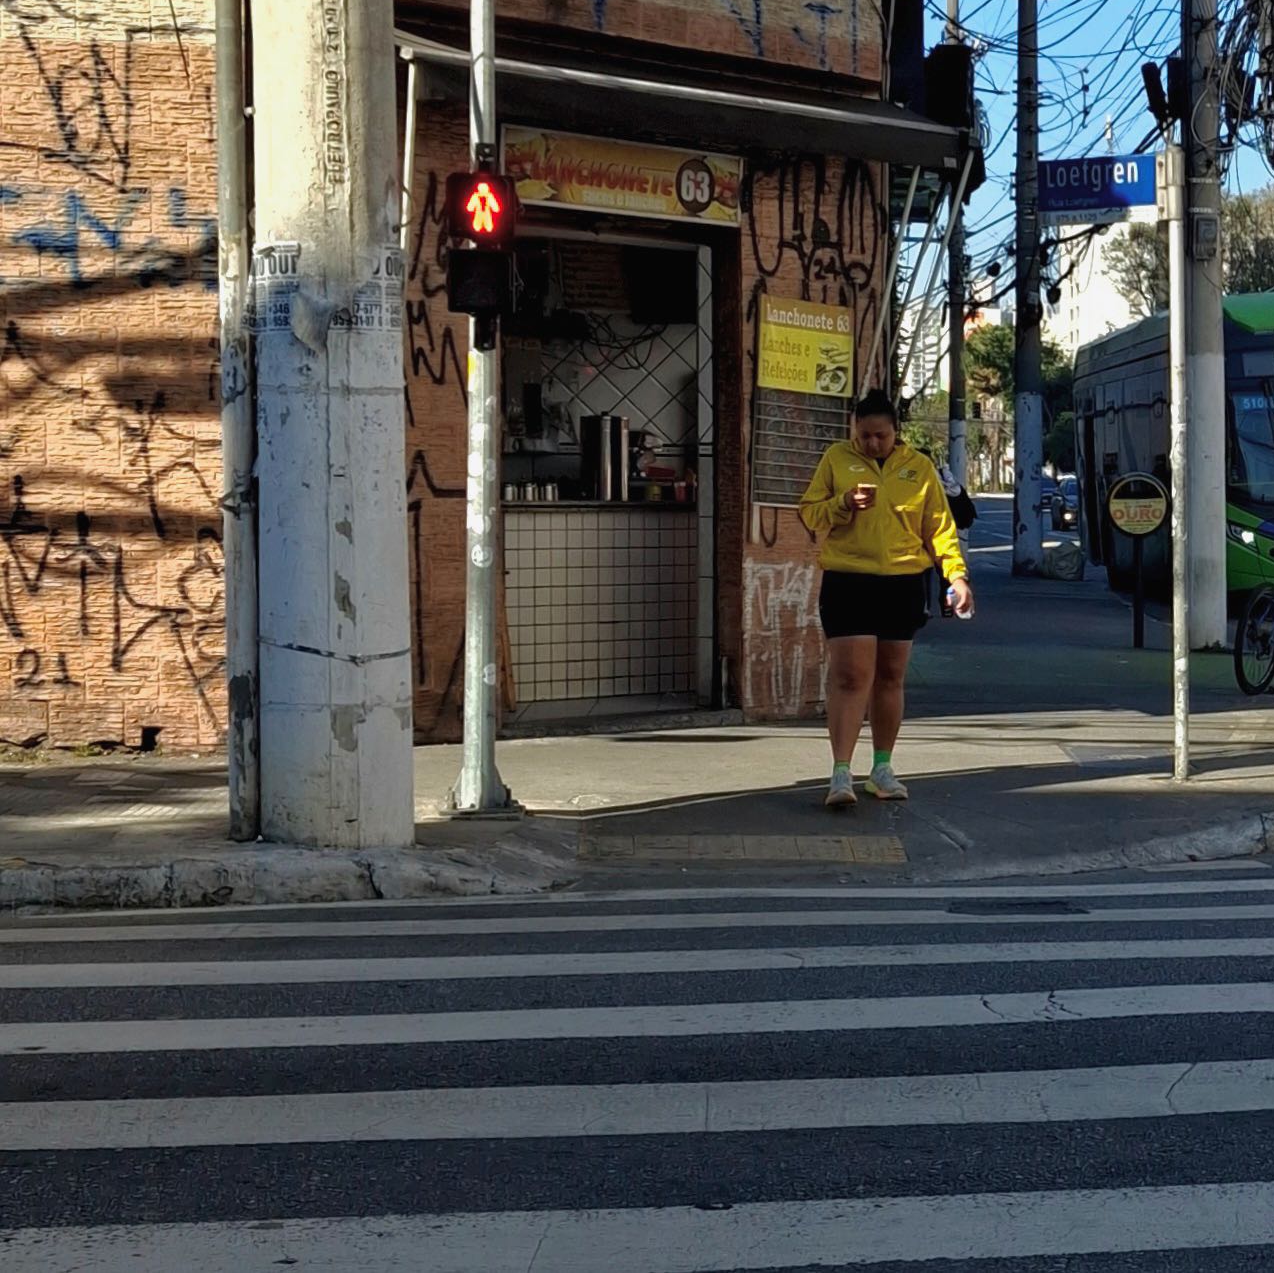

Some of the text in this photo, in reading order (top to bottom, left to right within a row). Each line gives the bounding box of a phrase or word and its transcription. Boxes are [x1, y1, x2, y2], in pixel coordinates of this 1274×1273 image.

[532, 154, 711, 204] LANCHONETE 63
[1046, 161, 1139, 192] Loefgren
[767, 303, 850, 333] Lanchonete 63
[762, 333, 811, 357] Lanches e
[762, 358, 809, 385] Refeições
[1113, 508, 1163, 520] OURO
